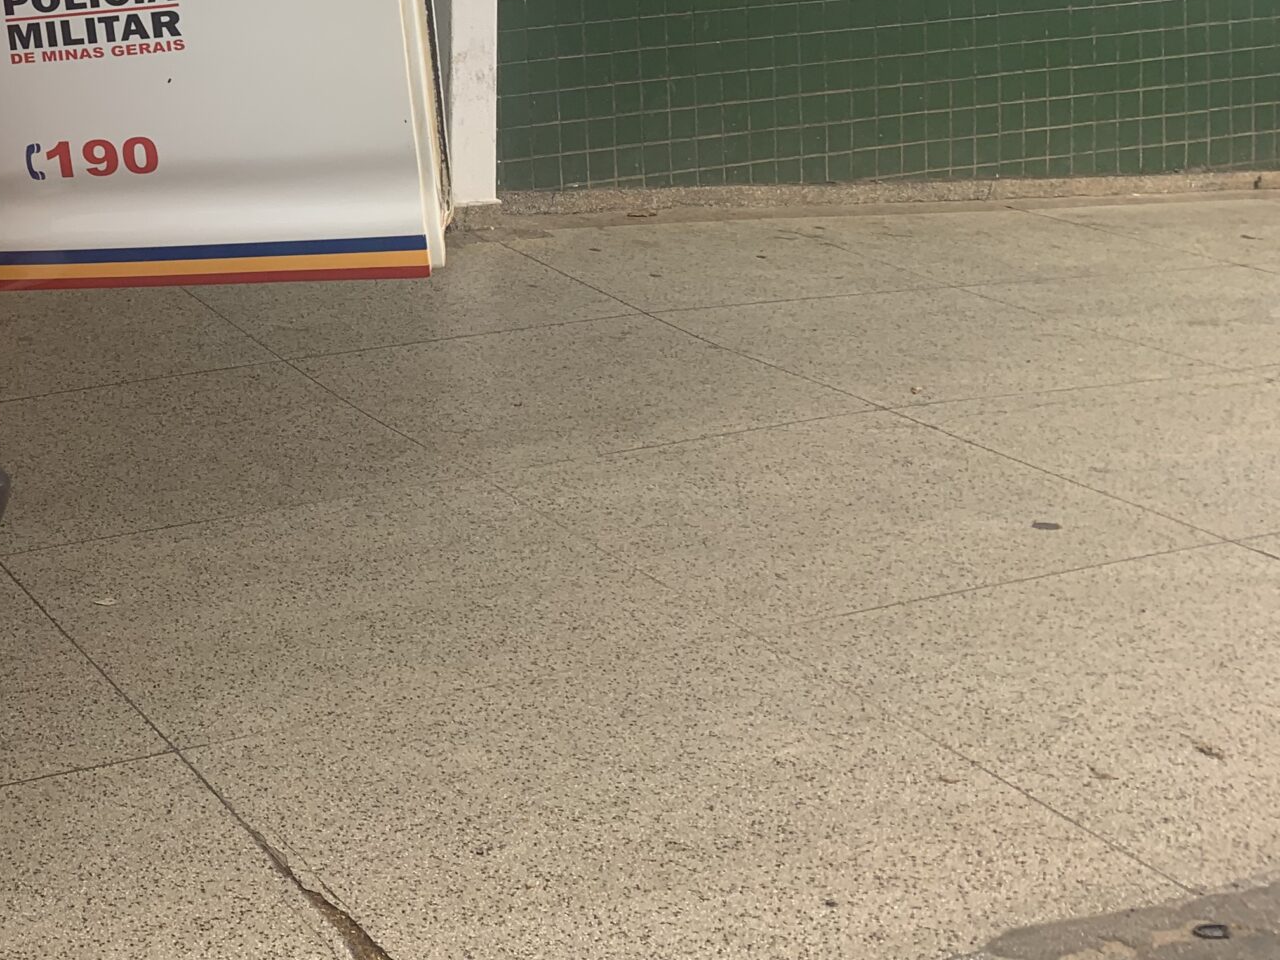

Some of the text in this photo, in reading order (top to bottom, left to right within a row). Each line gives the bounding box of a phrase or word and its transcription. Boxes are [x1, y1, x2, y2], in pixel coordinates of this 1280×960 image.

[7, 10, 182, 50] MILITAR
[10, 39, 185, 64] DE MINAS GERAIS
[46, 136, 159, 178] 190
